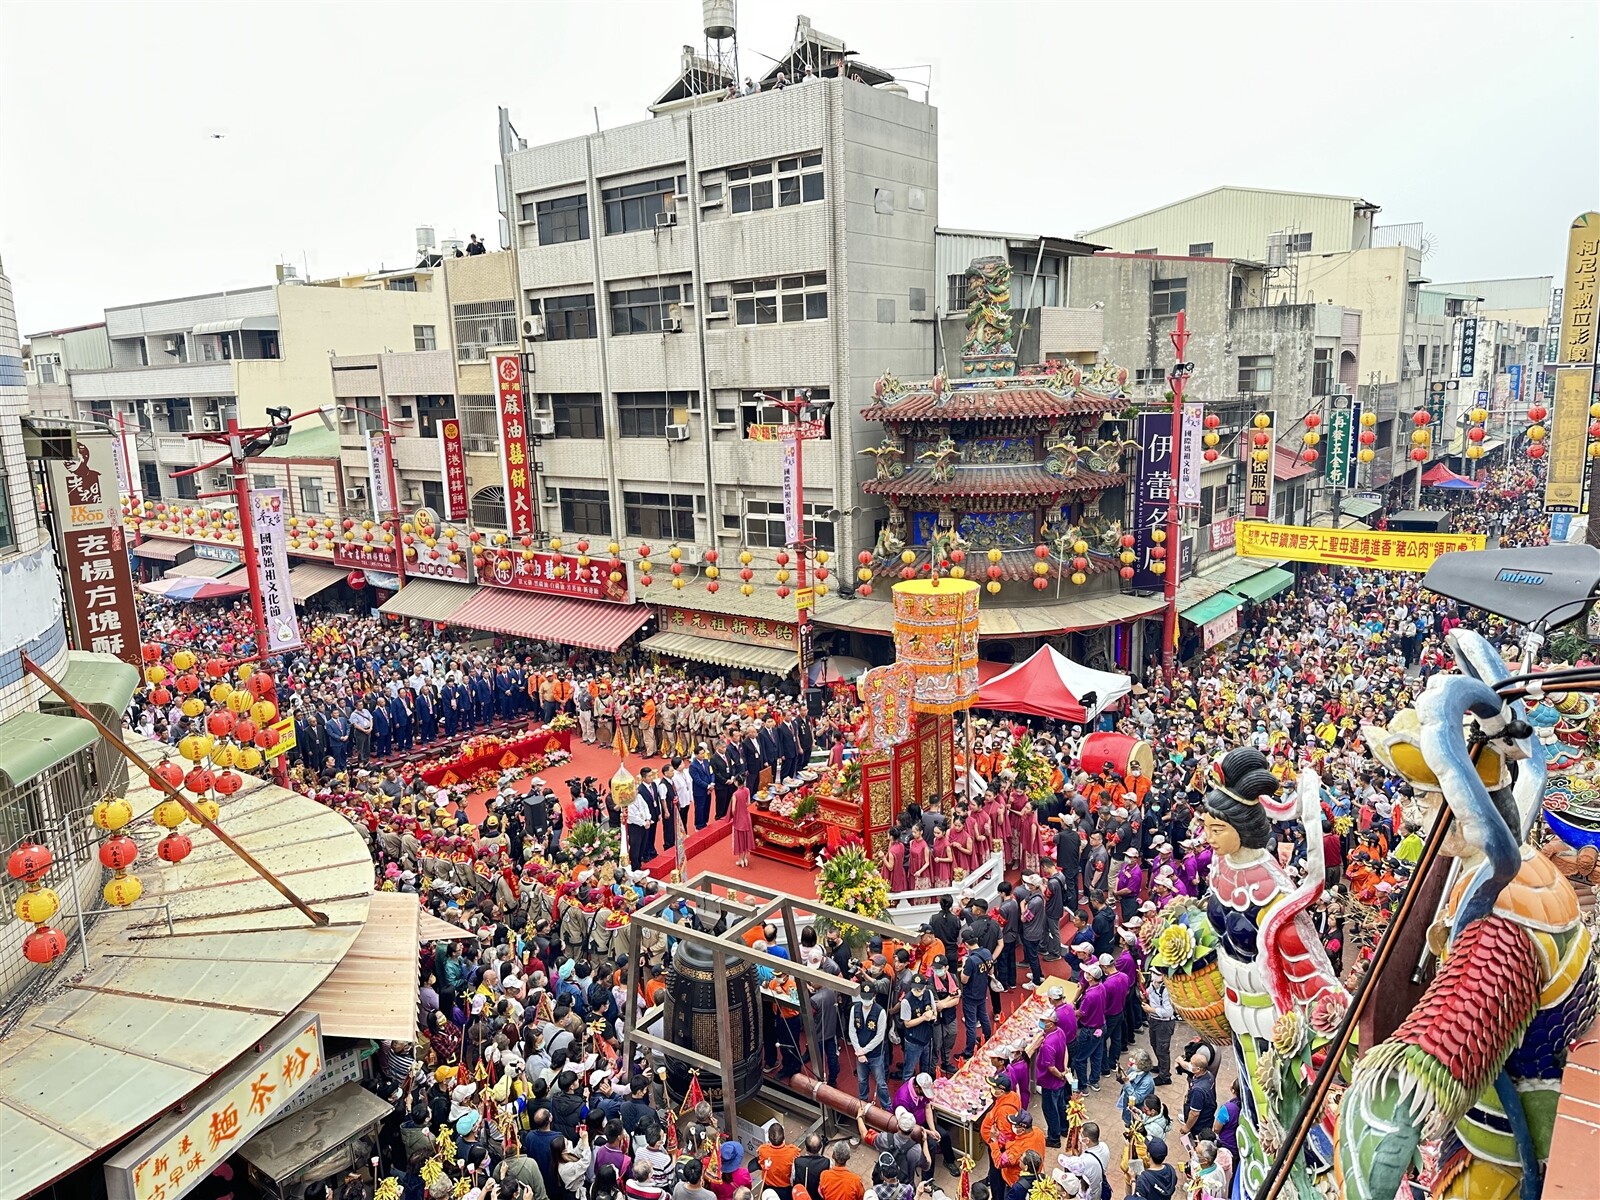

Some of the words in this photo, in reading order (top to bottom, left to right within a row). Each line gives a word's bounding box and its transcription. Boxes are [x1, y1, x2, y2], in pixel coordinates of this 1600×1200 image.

[1568, 240, 1599, 362] 柯尼卡數位影像
[501, 382, 520, 391] 新港
[503, 362, 517, 380] 徐
[1554, 376, 1586, 478] 東洋照相館
[1182, 430, 1192, 483] 國際媽祖文化節
[70, 505, 88, 515] TK
[71, 512, 104, 523] FOOD
[77, 534, 125, 654] 老楊方塊酥
[259, 532, 282, 618] 國際媽祖文化節
[1500, 573, 1544, 585] MIPRO
[671, 610, 793, 641] 老元祖新港飴
[207, 1046, 311, 1153] 麵茶粉
[153, 1134, 194, 1177] 新港
